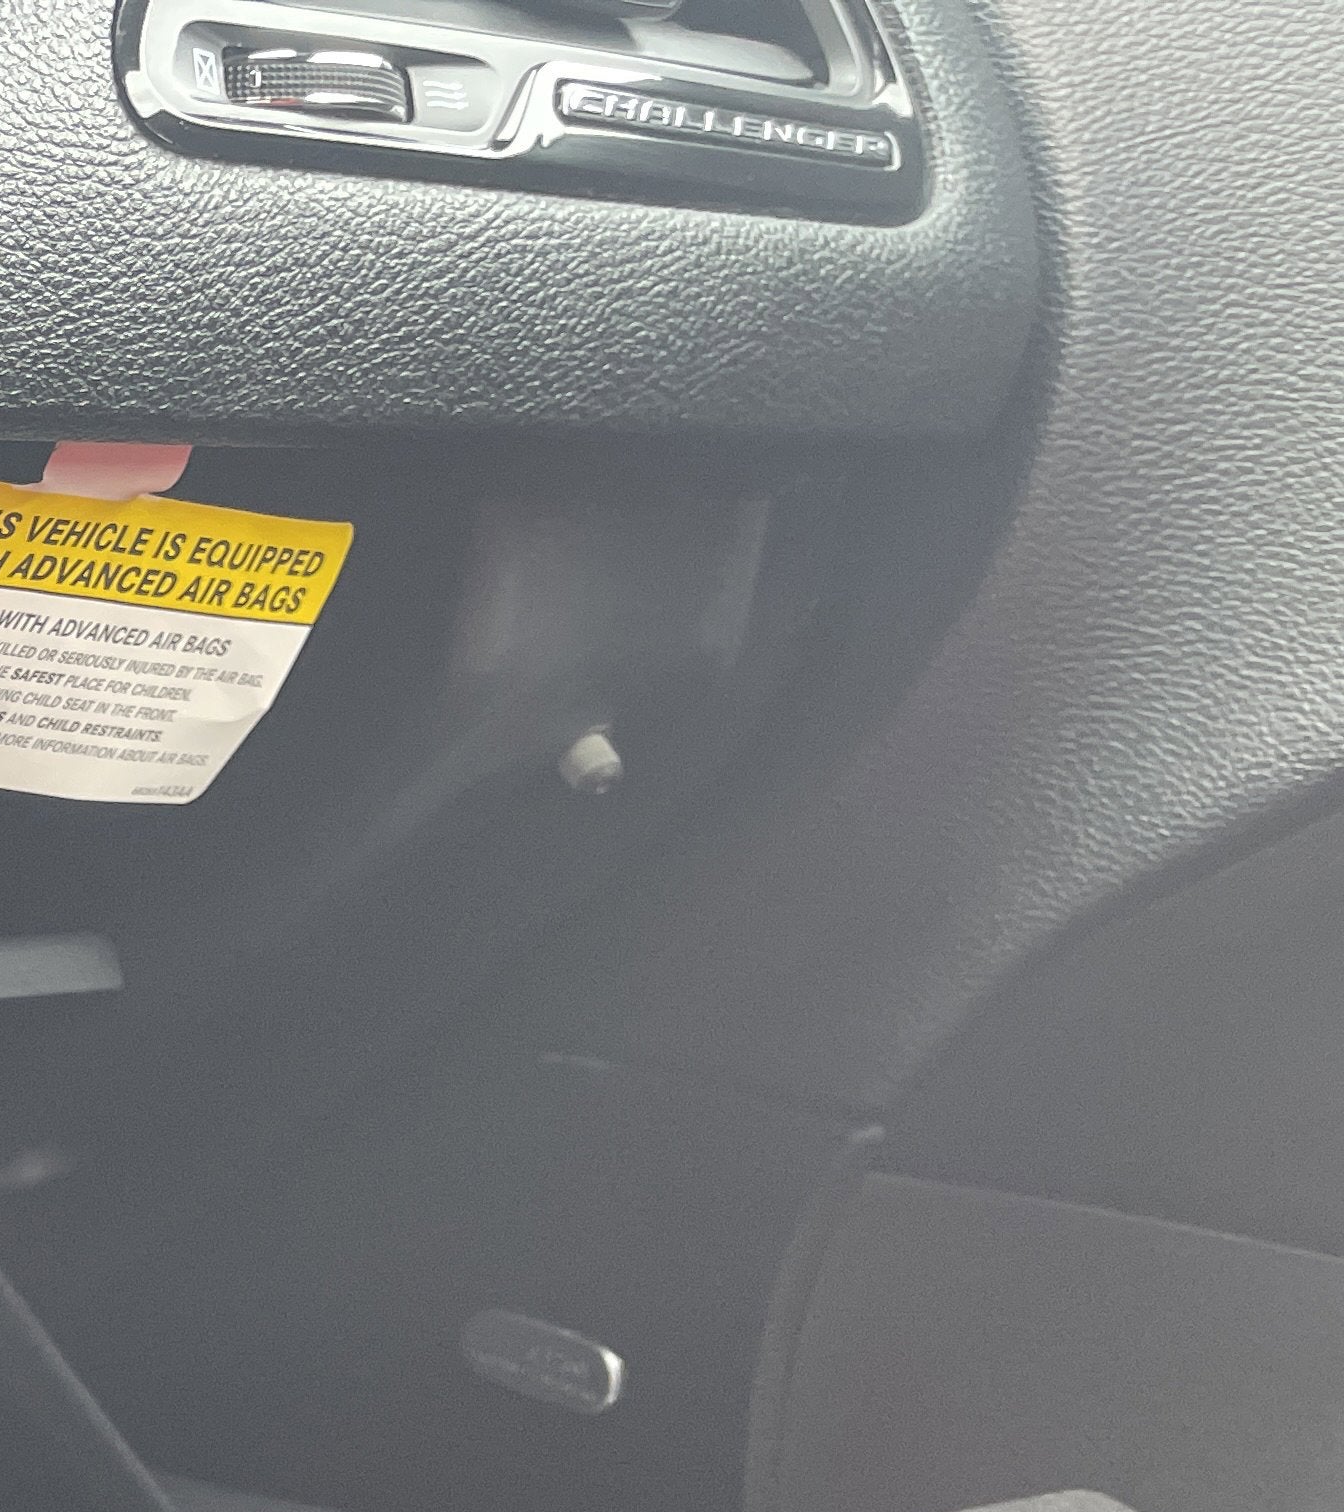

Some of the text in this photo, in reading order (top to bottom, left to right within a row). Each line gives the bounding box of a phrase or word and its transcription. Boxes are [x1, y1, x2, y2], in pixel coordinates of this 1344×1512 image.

[567, 94, 890, 155] CHALLENGER
[26, 515, 153, 556] VEHICLE
[152, 531, 187, 561] IS
[187, 536, 325, 577] EQUIPPED
[7, 553, 178, 598] ADVANCED
[176, 575, 232, 606] AIR
[232, 581, 306, 614] BAGS
[47, 617, 149, 646] ADVANCED
[148, 631, 184, 651] AIR
[181, 635, 232, 656] BAGS
[10, 668, 65, 686] SAFEST
[63, 674, 107, 690] PLACE
[104, 680, 131, 694] FOR
[37, 648, 58, 662] OR
[57, 651, 126, 670] SERIOUSLY
[125, 659, 177, 677] INJURED
[175, 665, 196, 679] BY
[193, 667, 218, 682] THE
[215, 669, 240, 684] AIR
[5, 712, 36, 727] AND
[36, 717, 81, 733] CHILD
[22, 692, 63, 708] CHILD
[62, 697, 96, 712] SEAT
[94, 702, 110, 715] IN
[110, 703, 137, 718] THE
[32, 737, 118, 759] INFORMATION
[116, 749, 158, 763] ABOUT
[157, 752, 177, 764] AIR
